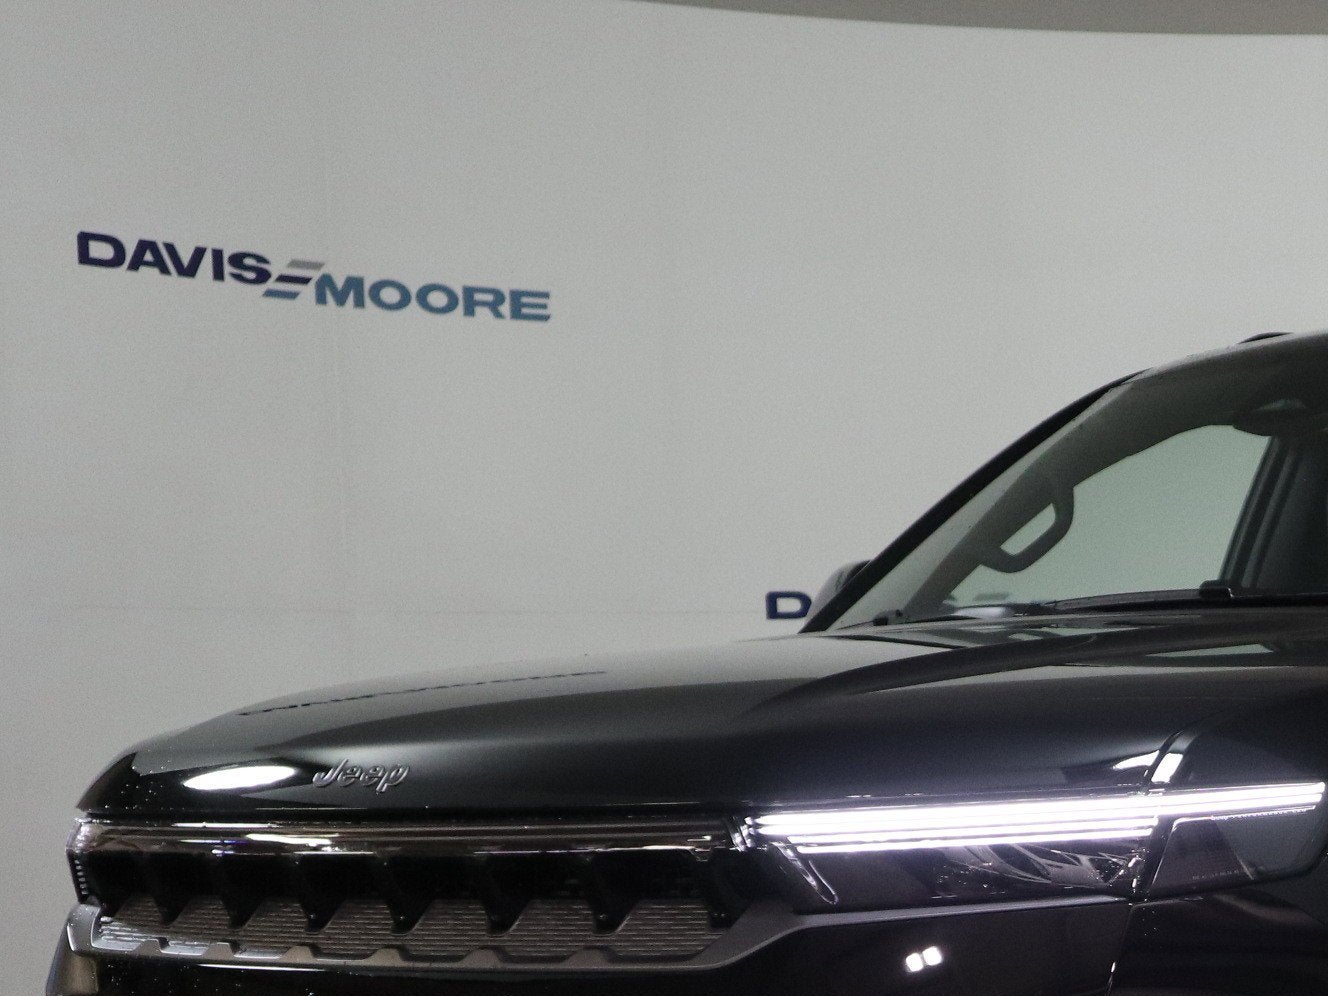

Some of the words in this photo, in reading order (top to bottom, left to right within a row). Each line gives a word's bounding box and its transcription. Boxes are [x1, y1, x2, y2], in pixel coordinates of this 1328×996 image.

[77, 231, 273, 286] DAVIS
[314, 272, 552, 322] MOORE
[312, 759, 410, 793] Jeep
